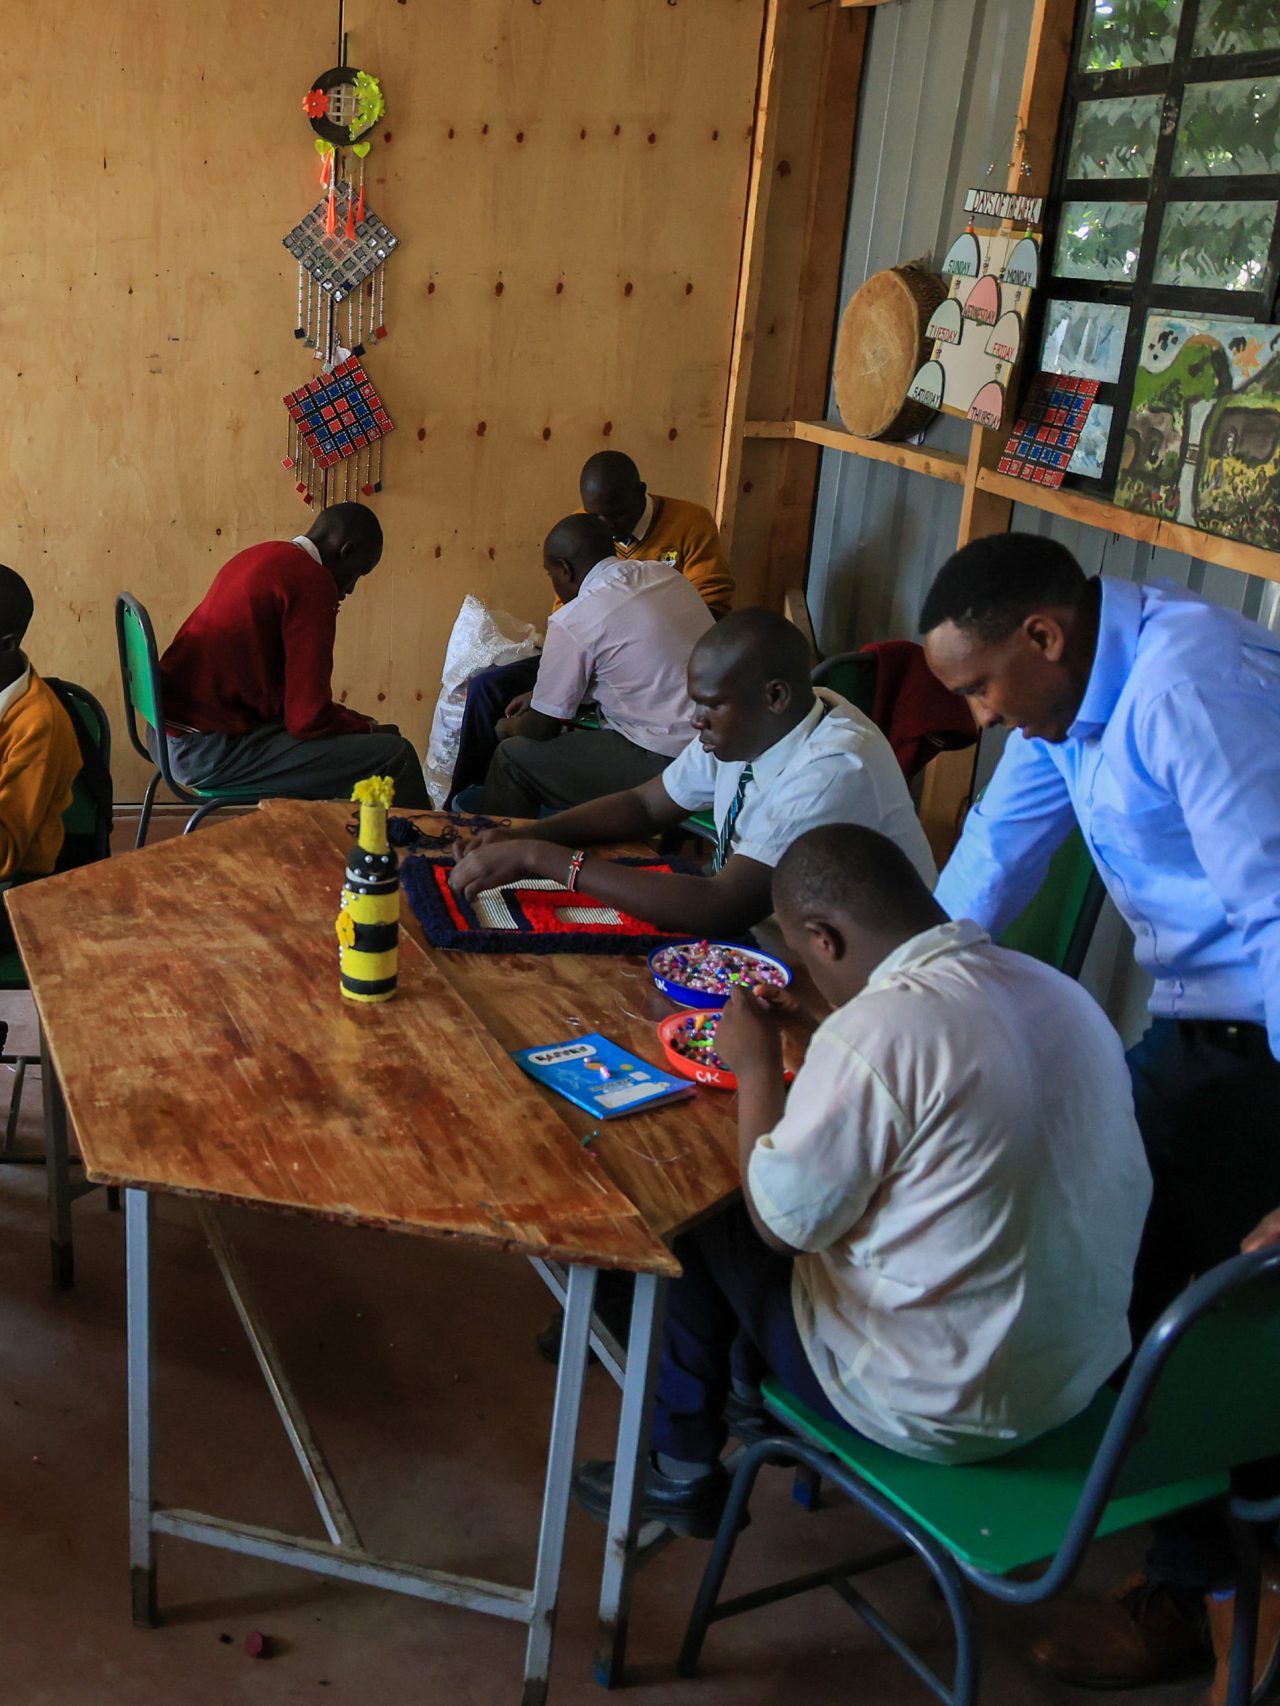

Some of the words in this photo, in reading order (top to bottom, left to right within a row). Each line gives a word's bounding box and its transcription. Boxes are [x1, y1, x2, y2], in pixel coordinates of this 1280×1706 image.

[948, 260, 971, 274] SUNDAY
[1007, 270, 1033, 284] MONDAY
[929, 325, 958, 341] TUESDAY
[993, 342, 1015, 359] FRIDAY
